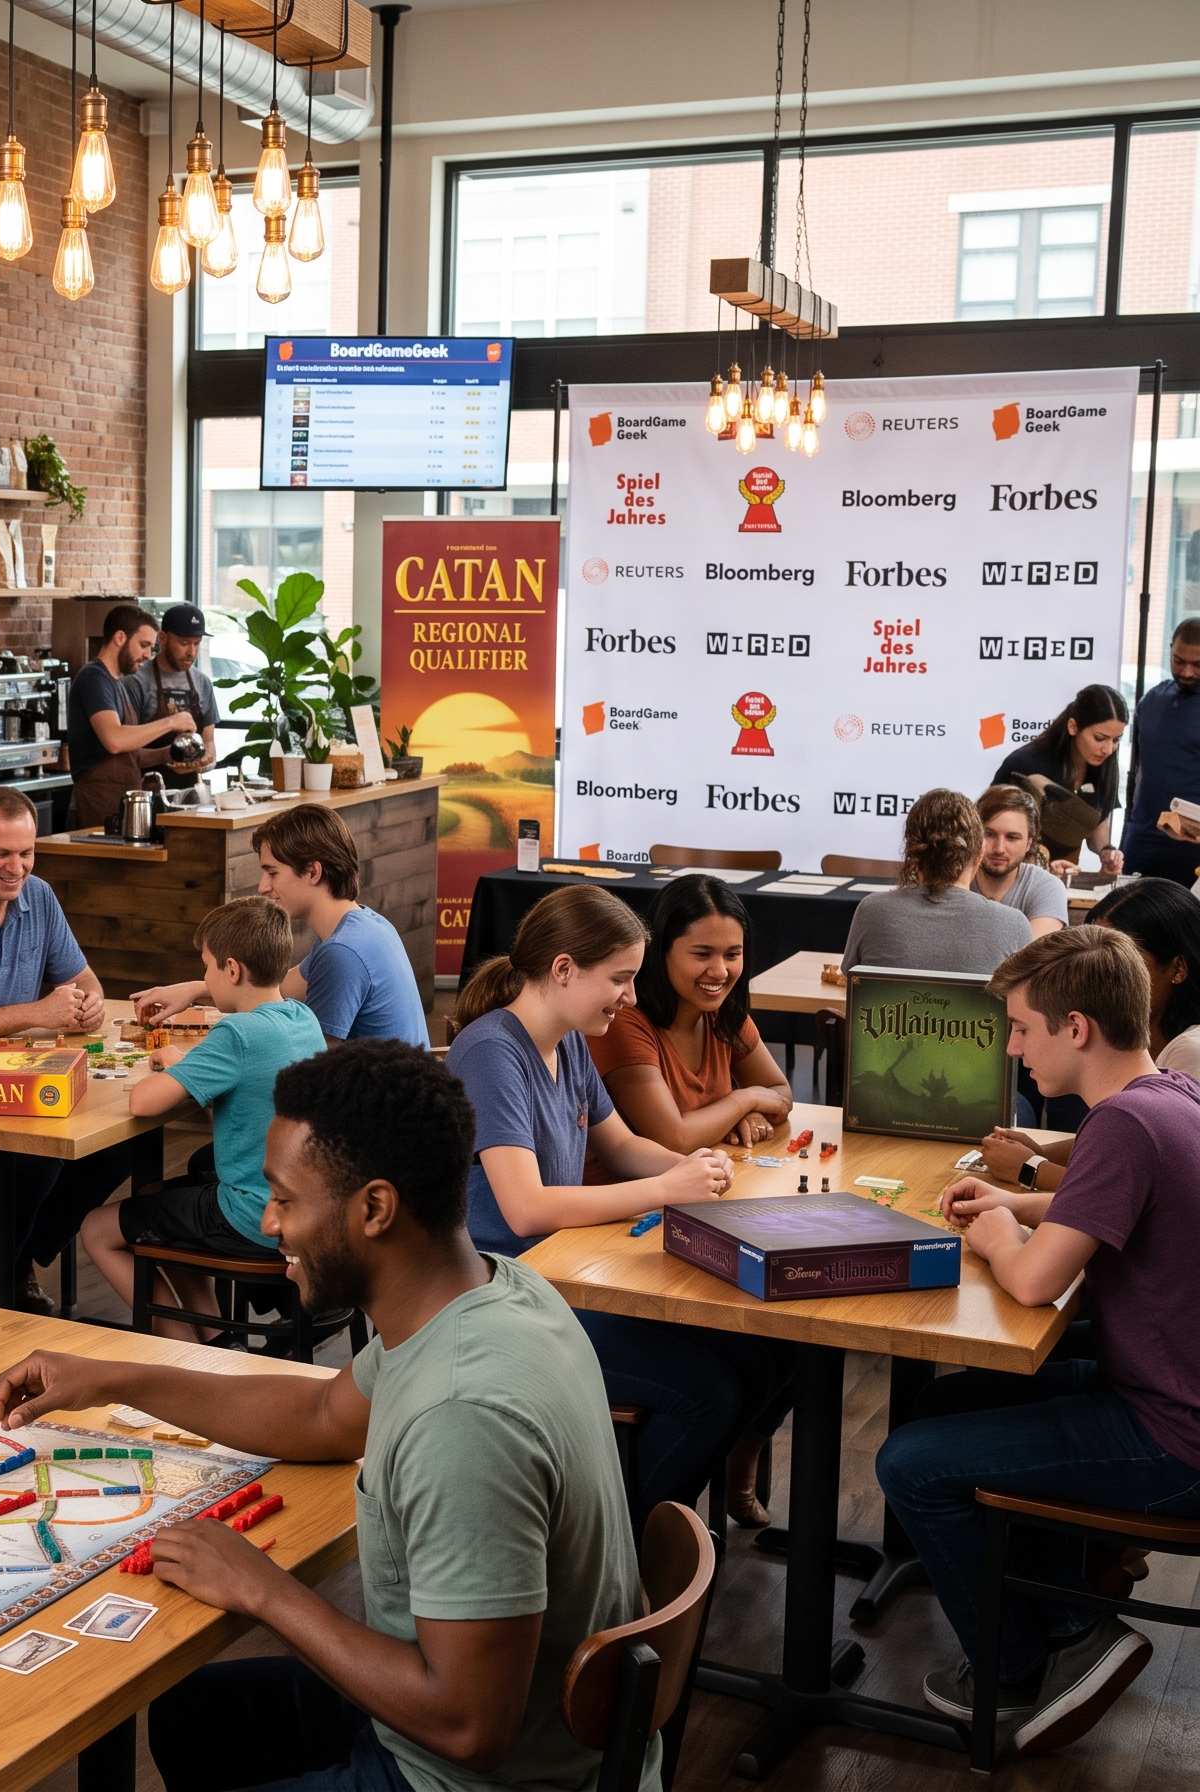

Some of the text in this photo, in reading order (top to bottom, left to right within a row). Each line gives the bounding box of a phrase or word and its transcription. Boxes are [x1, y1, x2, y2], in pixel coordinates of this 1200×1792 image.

[330, 342, 449, 358] BoardGameGeek
[617, 416, 687, 428] BoardGame
[1026, 406, 1107, 419] BoardGame
[617, 429, 648, 440] Geek
[882, 417, 959, 431] REUTERS
[1025, 422, 1060, 433] Geek
[616, 473, 660, 494] Spiel
[624, 491, 655, 507] des
[842, 489, 956, 511] Bloomberg
[989, 483, 1098, 511] Forbes
[606, 508, 666, 525] Jahres
[395, 556, 547, 603] CATAN
[615, 565, 684, 578] REUTERS
[705, 563, 815, 586] Bloomberg
[845, 561, 947, 587] Forbes
[982, 561, 1099, 586] WIRED
[412, 622, 526, 643] REGIONAL
[873, 619, 921, 640] Spiel
[585, 627, 676, 654] Forbes
[706, 632, 811, 657] WIRED
[880, 638, 914, 655] des
[979, 636, 1094, 660] WIRED
[409, 648, 529, 674] QUALIFIER
[863, 657, 927, 674] Jahres
[610, 706, 678, 719] BoardGame
[609, 719, 640, 730] Geek
[871, 723, 946, 737] REUTERS
[1012, 718, 1051, 731] Board
[576, 780, 678, 805] Bloomberg
[705, 784, 801, 813] Forbes
[833, 791, 913, 817] WIRE
[440, 909, 470, 928] CAT
[859, 1001, 997, 1051] Villainous
